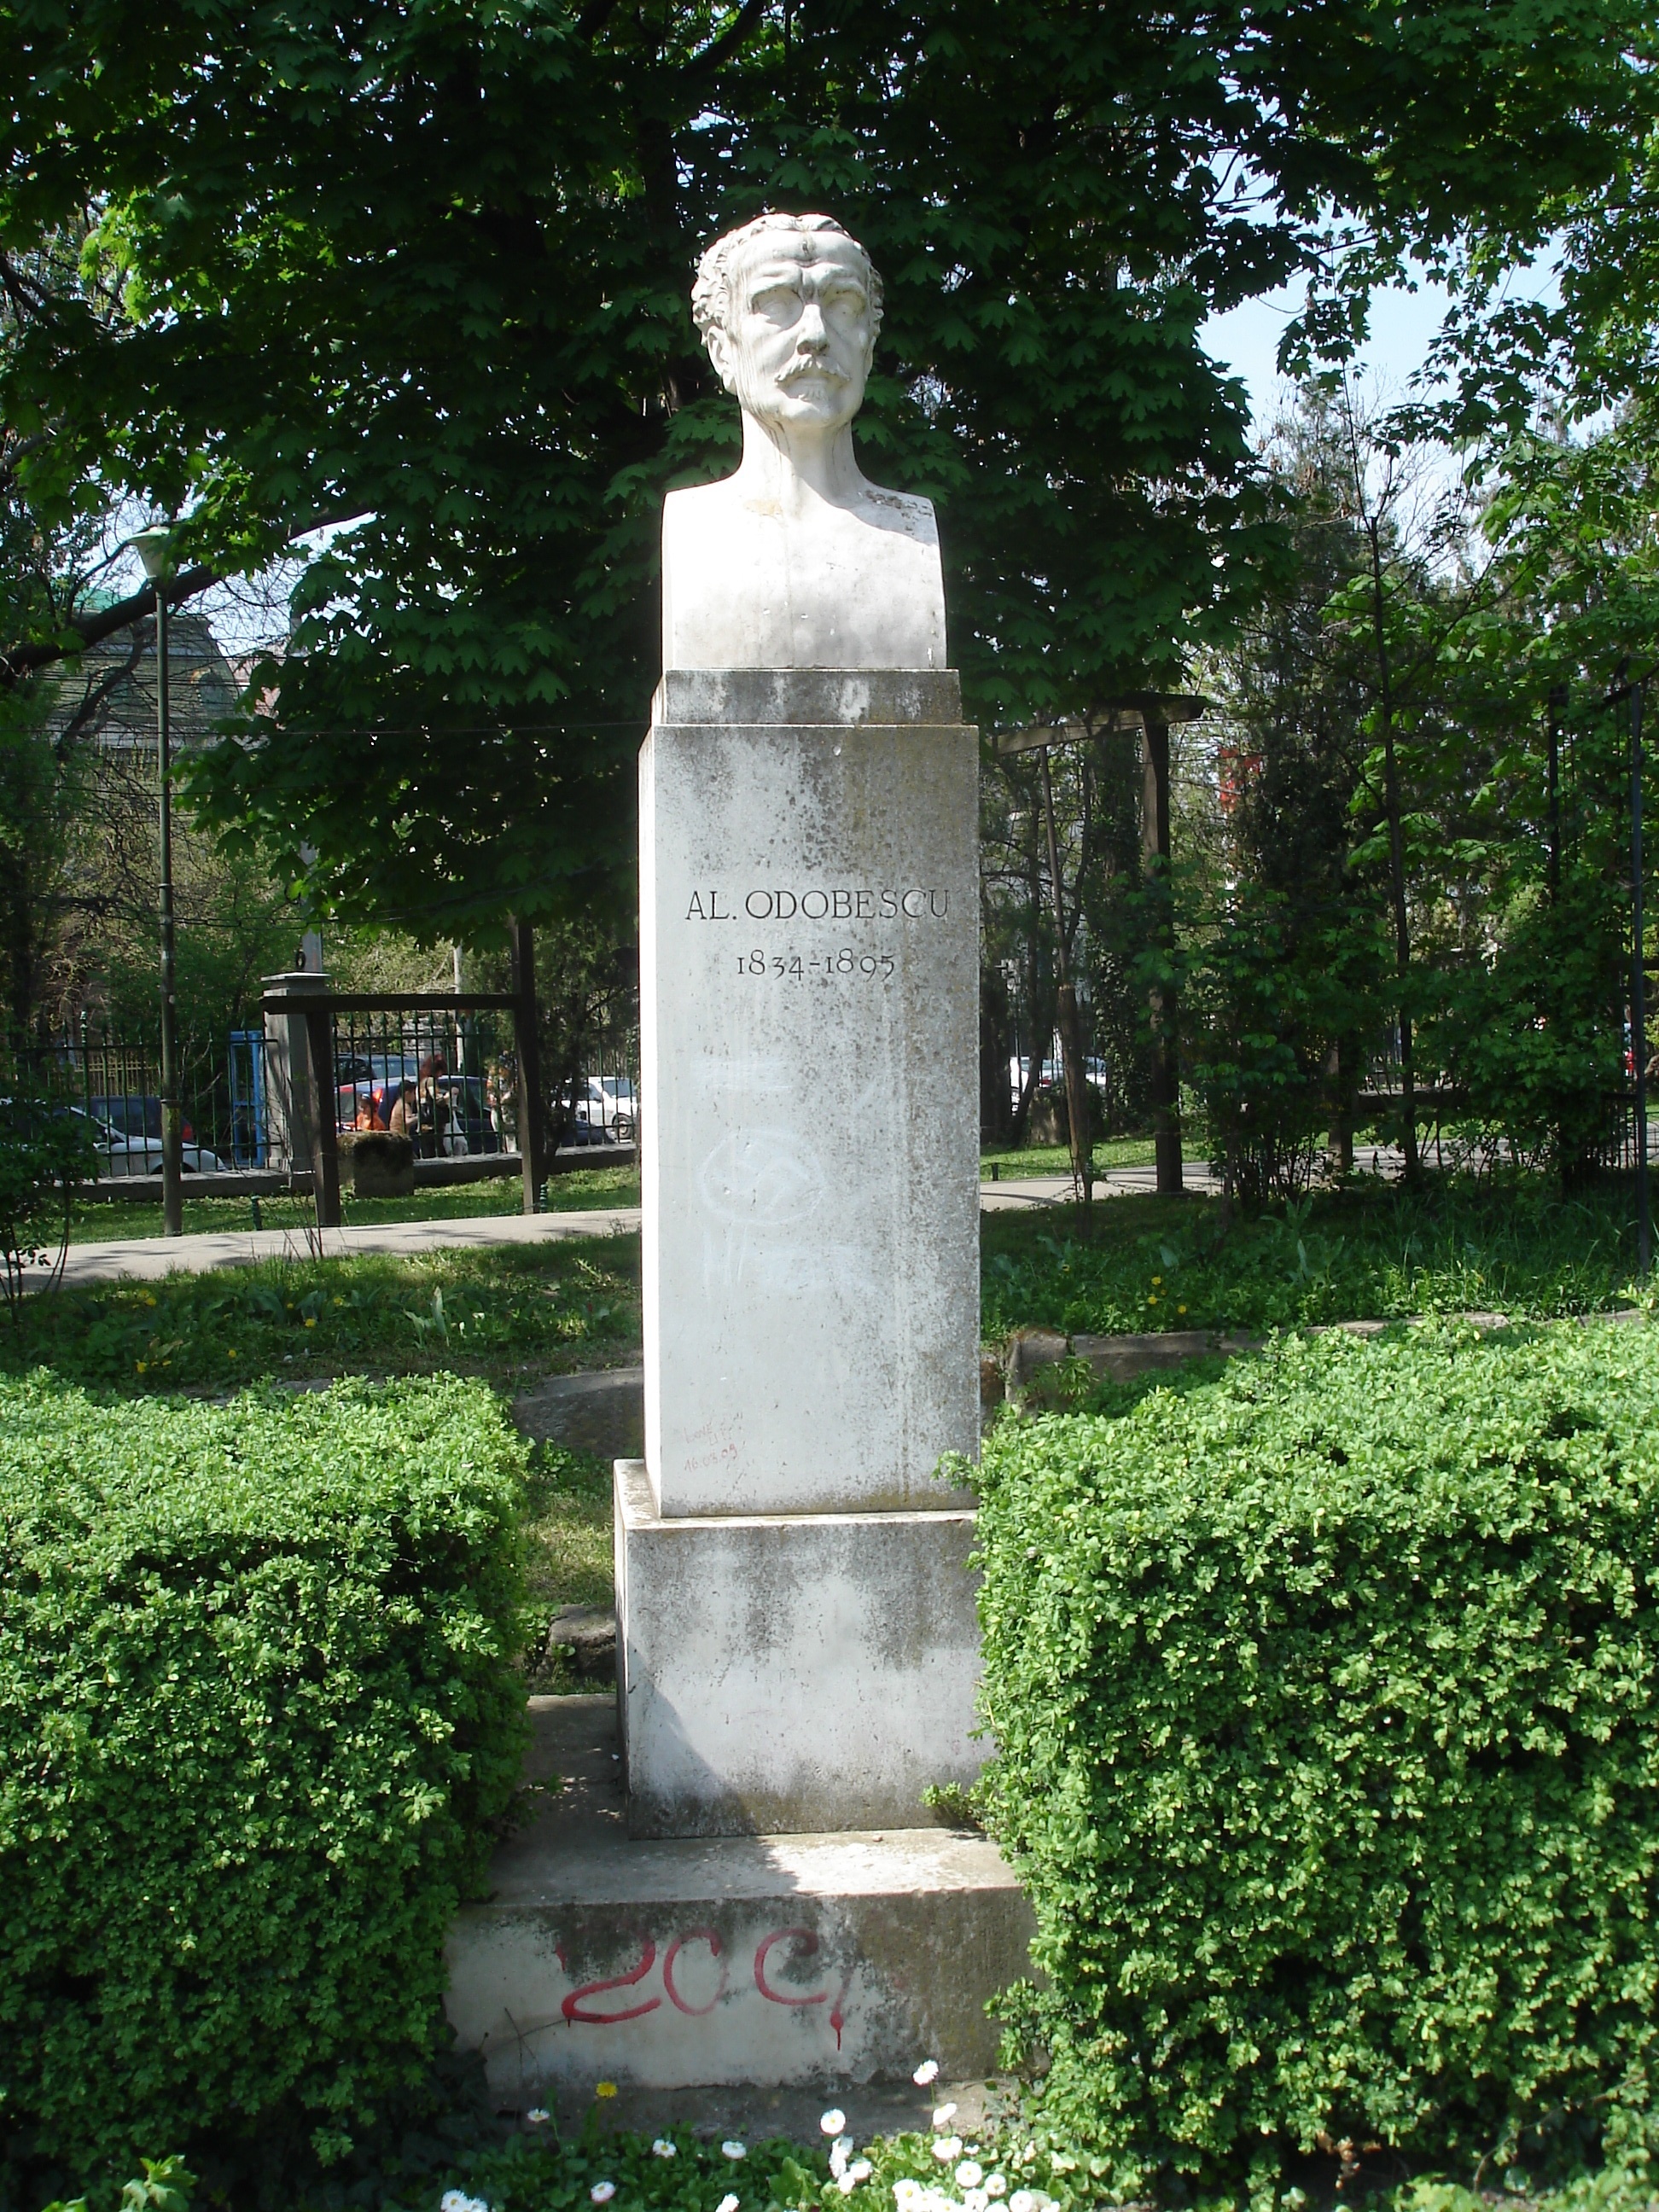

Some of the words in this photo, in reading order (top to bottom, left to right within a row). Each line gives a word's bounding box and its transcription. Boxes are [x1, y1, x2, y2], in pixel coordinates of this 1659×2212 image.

[684, 890, 737, 921] AL.
[745, 888, 949, 920] ODOBESCU
[736, 947, 895, 982] 1834-1895
